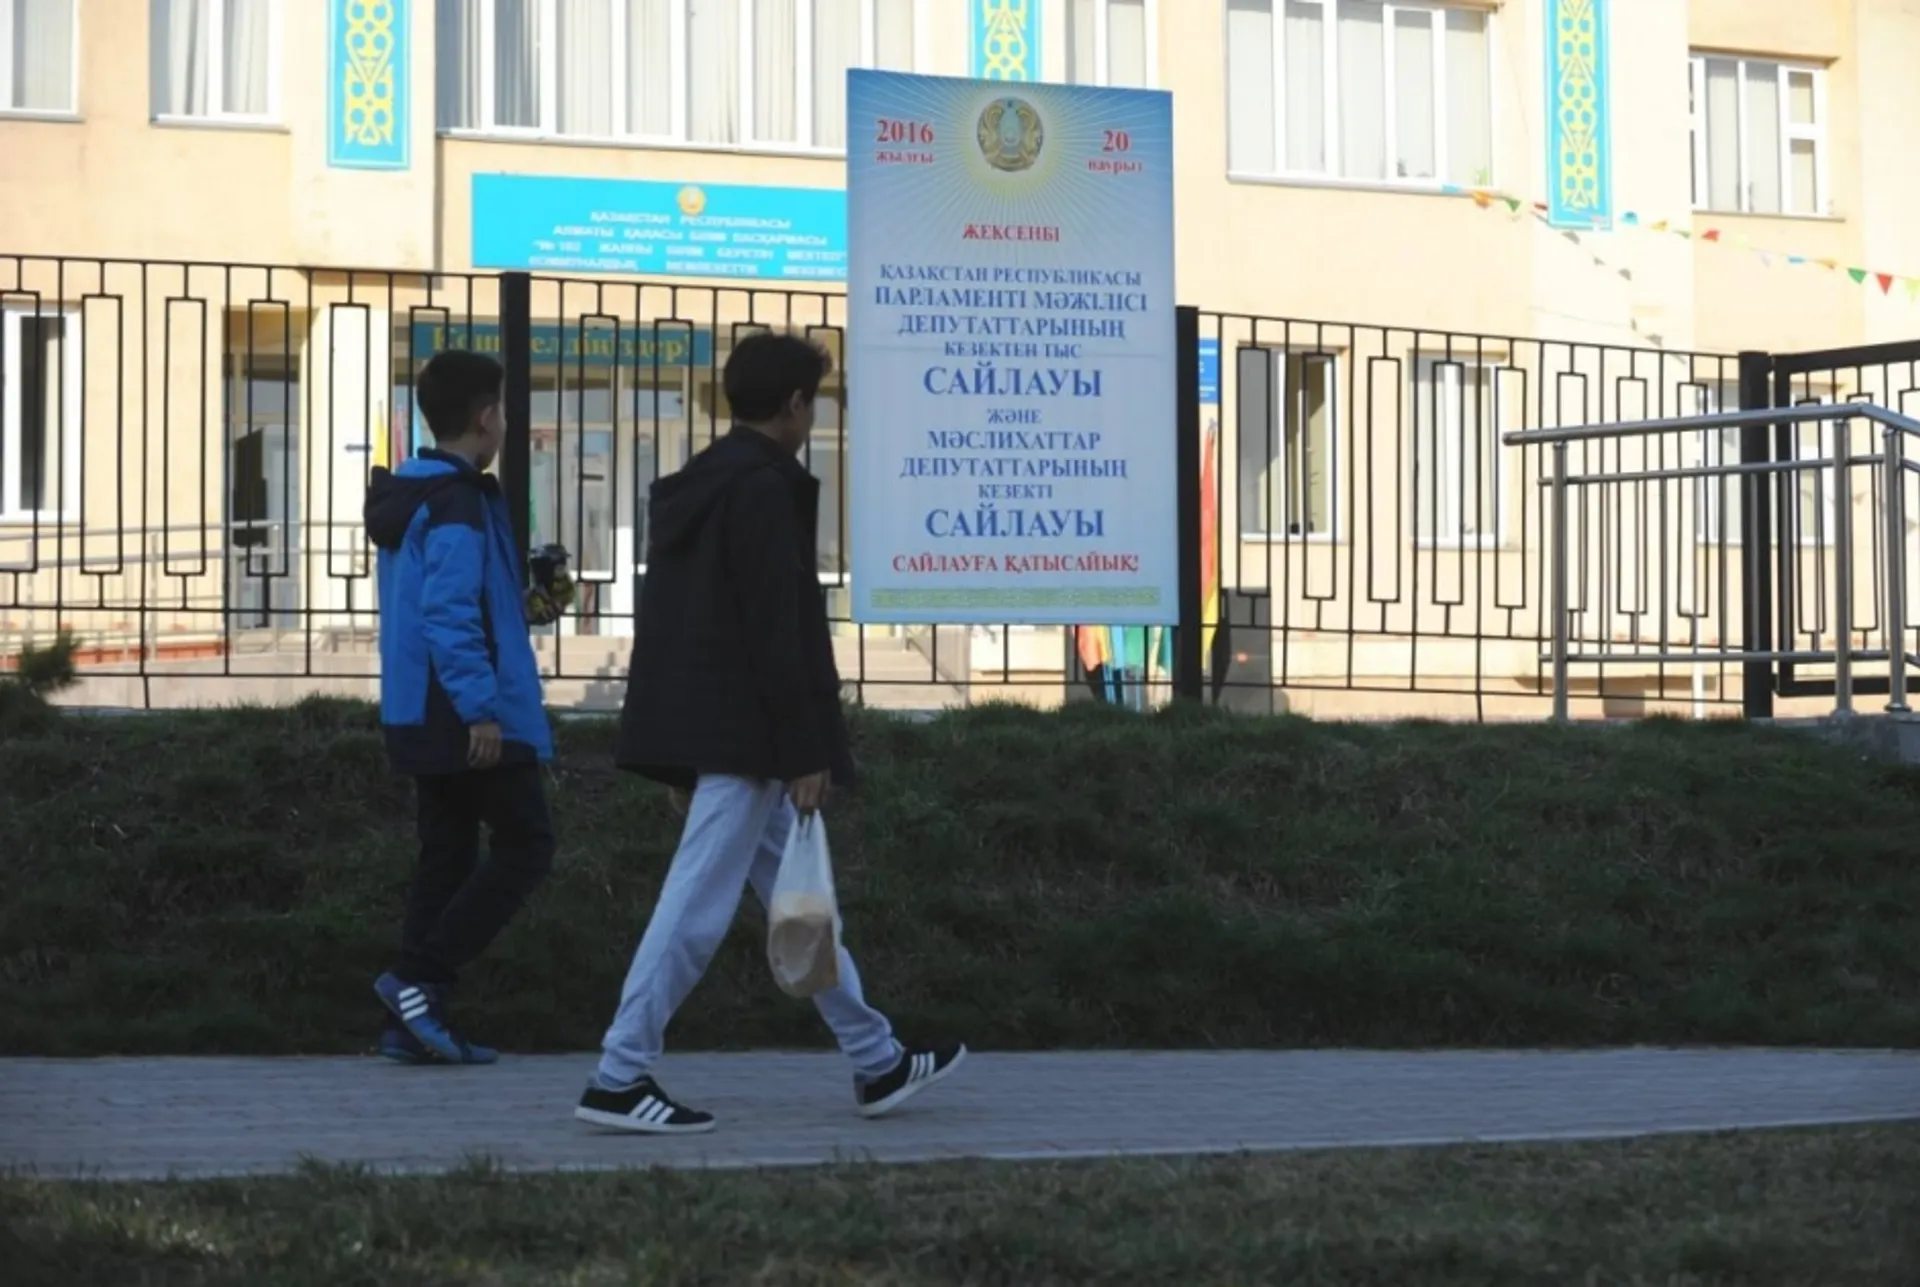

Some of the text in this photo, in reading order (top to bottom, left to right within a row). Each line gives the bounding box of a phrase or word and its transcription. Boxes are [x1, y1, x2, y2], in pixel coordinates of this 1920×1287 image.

[876, 119, 935, 144] 2016
[1102, 129, 1130, 152] 20
[962, 223, 1060, 243] ЖЕКСЕНБІ
[994, 268, 1142, 286] РЕСПУБЛИКАСЫ
[875, 286, 1148, 312] ПАРЛАМЕНТІ МӘЖІЛІСІ
[898, 314, 1126, 340] ДЕПУТАТТАРЫНЫҢ
[945, 341, 1083, 359] КЕЗЕКТЕН ТЫС
[923, 361, 1103, 397] САЙЛАУЫ
[987, 408, 1042, 424] ЖӘНЕ
[927, 430, 1101, 450] МӘСЛИХАТТАР
[899, 457, 1128, 479] ДЕПУТАТТАРЫНЫҢ
[978, 484, 1053, 500] КЕЗЕКТІ
[925, 503, 1105, 538] САЙЛАУЫ
[892, 552, 999, 573] САЙЛАУҒА
